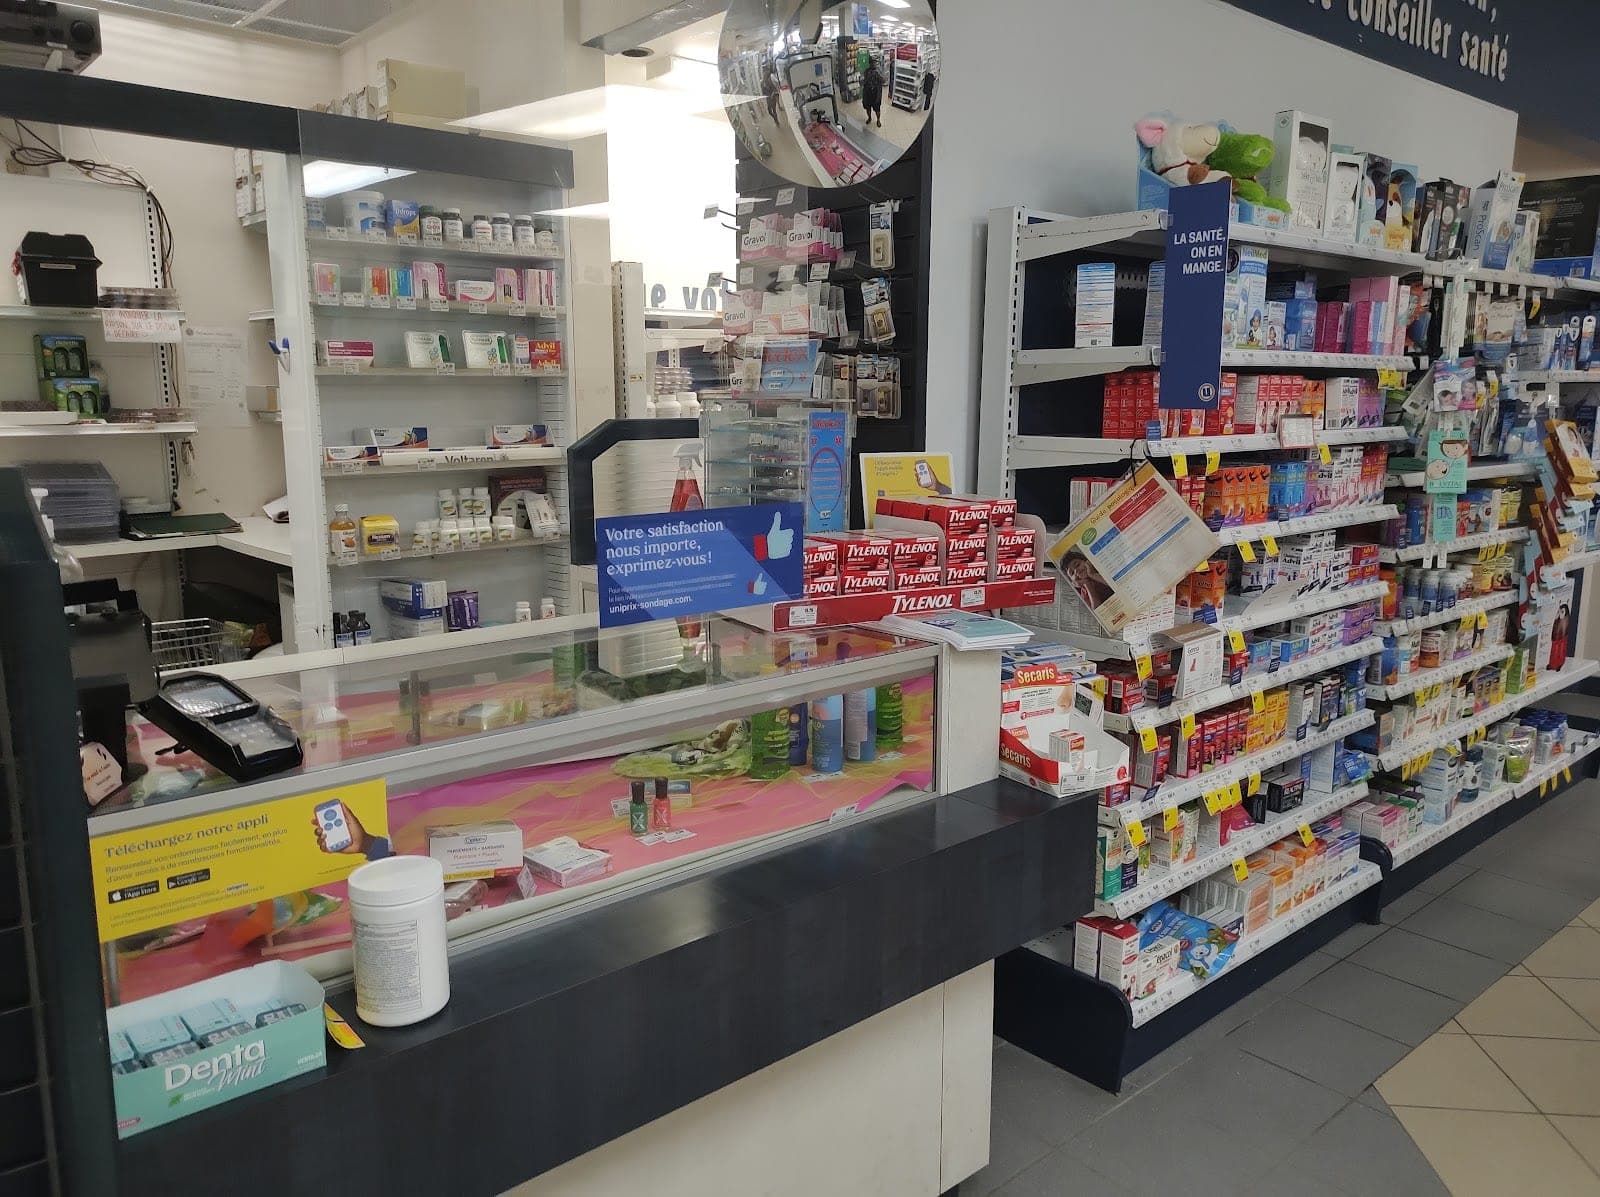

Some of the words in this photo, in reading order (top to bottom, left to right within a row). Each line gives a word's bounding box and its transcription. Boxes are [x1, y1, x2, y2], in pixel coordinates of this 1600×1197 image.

[1347, 0, 1451, 59] conseiller
[1459, 31, 1510, 82] santé
[743, 232, 768, 246] Gravol
[788, 230, 814, 242] Gravol
[1174, 232, 1187, 245] LA
[1188, 226, 1226, 244] SANTÉ,
[1190, 246, 1207, 259] ON
[1208, 244, 1223, 257] EN
[1182, 260, 1225, 275] MANGE.
[724, 310, 746, 321] Gravol
[536, 342, 556, 350] Advil
[949, 509, 989, 523] TYLENOL
[991, 504, 1015, 515] ENOL
[605, 526, 644, 543] Votre
[648, 519, 724, 539] satisfaction
[606, 546, 641, 560] nous
[644, 538, 702, 556] importe,
[847, 544, 889, 558] TYLENOL
[893, 541, 938, 556] TYLENOL
[949, 538, 986, 552] TYLENOL
[803, 550, 837, 564] YLENOL
[946, 567, 986, 580] TYLENOL
[996, 562, 1035, 576] TYLENOL
[844, 575, 888, 589] TYLENOL
[897, 572, 940, 587] TYLENOL
[803, 582, 837, 595] LENOL
[891, 593, 954, 614] TYLENOL
[1017, 666, 1056, 684] Secaris
[1000, 743, 1032, 769] Secaris
[104, 831, 193, 858] Téléchargez
[197, 822, 233, 839] notre
[236, 813, 269, 832] appli
[164, 1039, 267, 1091] Denta
